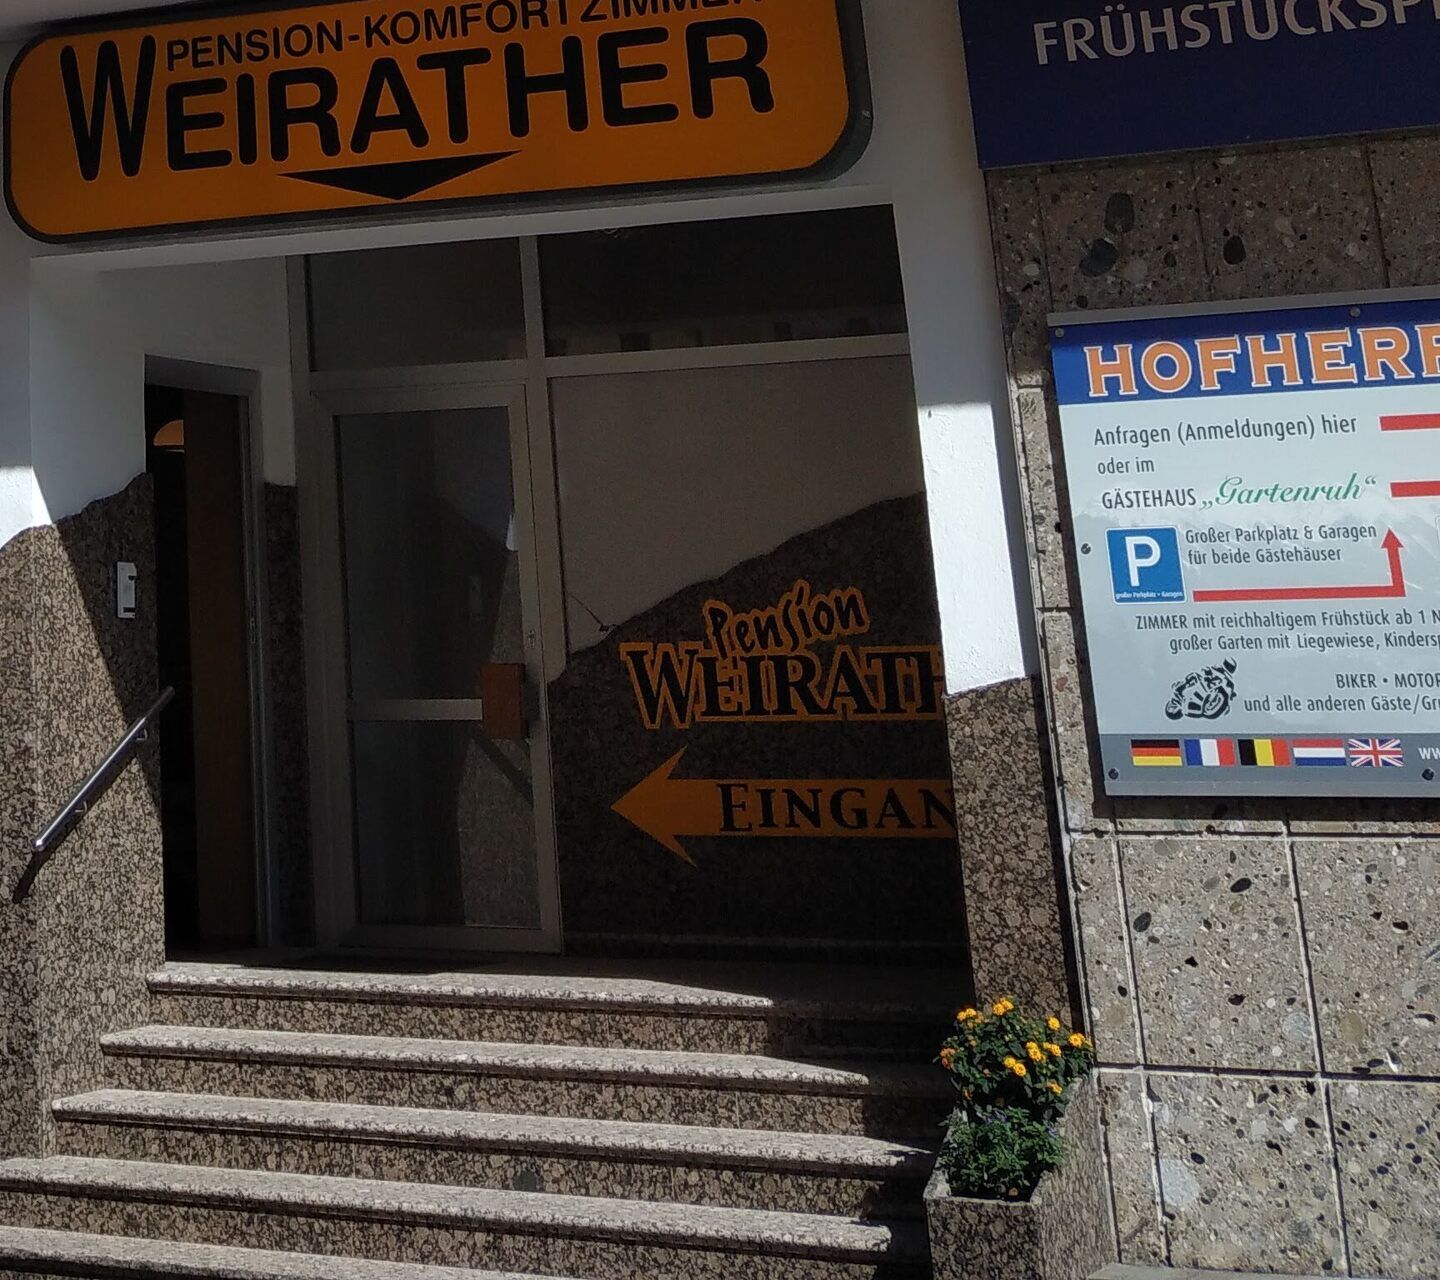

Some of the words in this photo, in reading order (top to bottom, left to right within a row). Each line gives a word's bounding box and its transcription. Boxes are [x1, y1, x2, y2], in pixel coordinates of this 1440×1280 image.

[59, 16, 775, 182] WEIRATHER
[1094, 424, 1171, 448] Anfragen
[1177, 414, 1315, 447] (Anmeldungen)
[1321, 413, 1358, 435] hier
[1097, 457, 1130, 476] oder
[1135, 456, 1155, 474] im
[1101, 487, 1197, 511] GÄSTEHAUS
[1185, 526, 1231, 545] Großer
[1234, 523, 1298, 546] Parkplatz
[1304, 525, 1314, 541] &
[1318, 523, 1378, 542] Garagen
[1125, 535, 1161, 587] P
[1188, 548, 1208, 566] für
[1212, 546, 1251, 565] beide
[1255, 545, 1342, 563] Gästehäuser
[704, 582, 867, 660] Pension
[1135, 614, 1188, 630] ZIMMER
[1192, 612, 1217, 629] mit
[1220, 610, 1317, 632] reichhaltigem
[1321, 608, 1390, 627] Frühstück
[1395, 608, 1413, 625] ab
[1418, 609, 1427, 625] 1
[1169, 634, 1213, 654] großer
[1217, 633, 1263, 651] Garten
[1267, 632, 1291, 650] mit
[1295, 631, 1380, 654] Liegewiese,
[1335, 673, 1378, 689] BIKER
[1243, 695, 1271, 713] und
[1275, 695, 1302, 712] alle
[1307, 693, 1367, 712] anderen
[1370, 692, 1440, 715] Gäste/Gr
